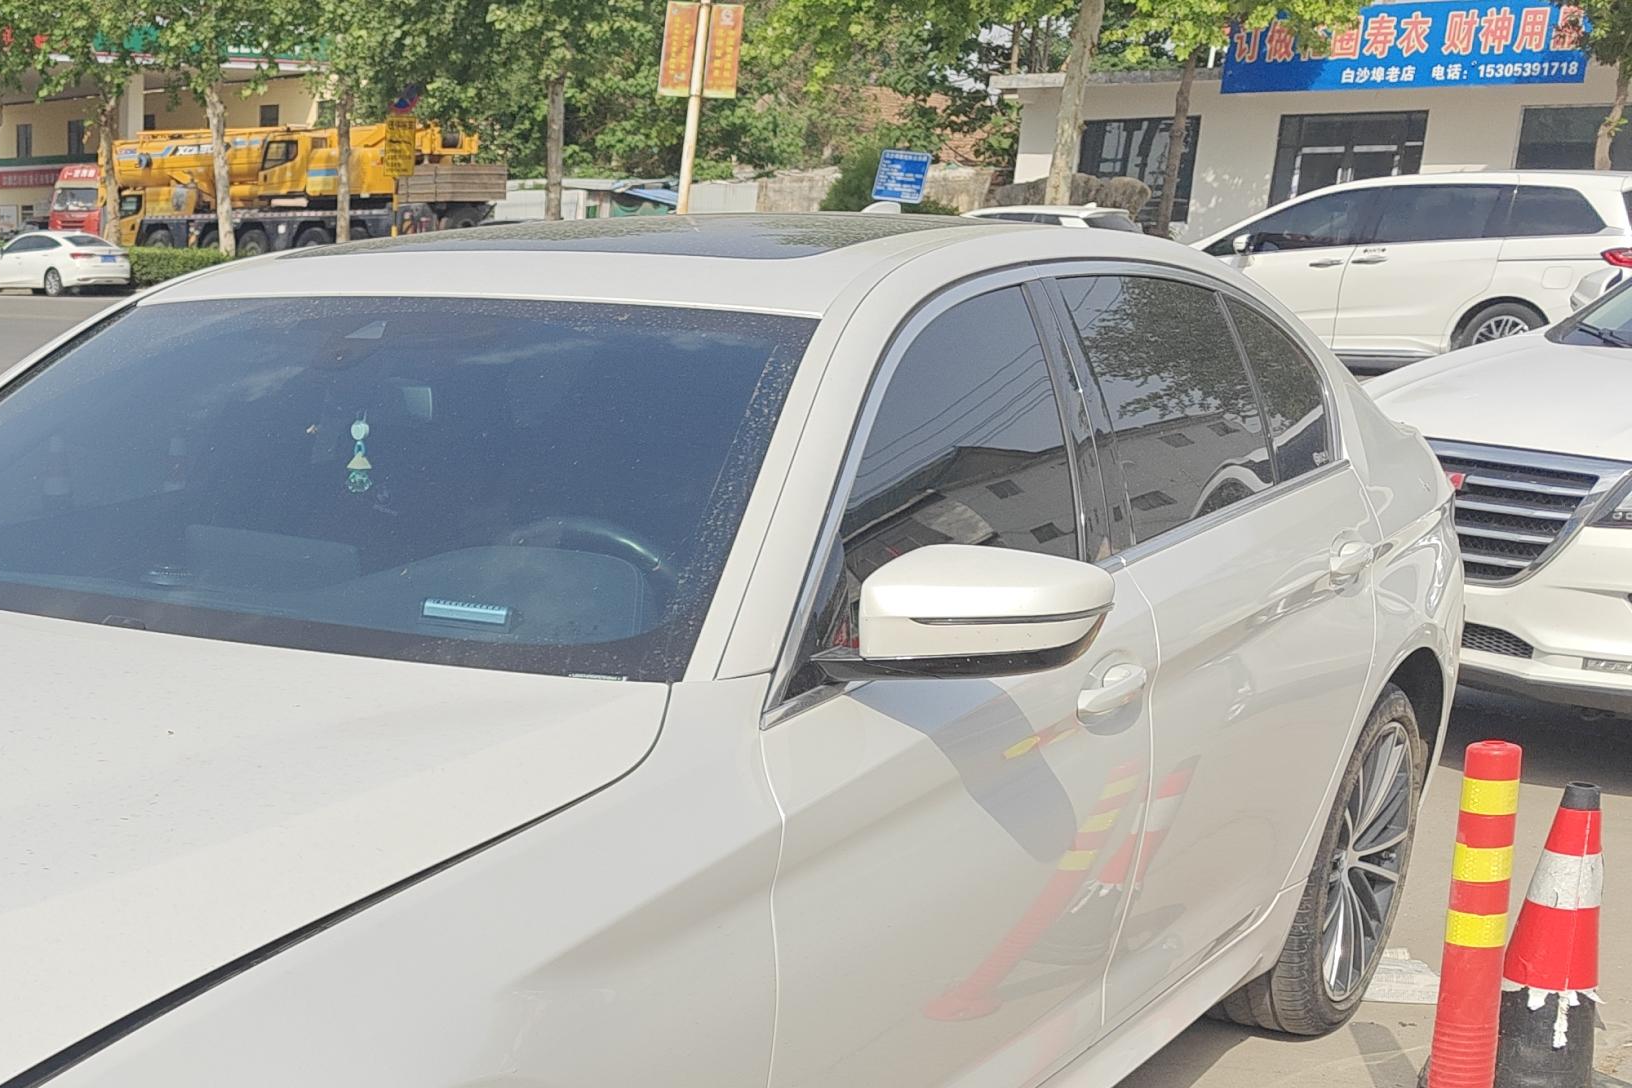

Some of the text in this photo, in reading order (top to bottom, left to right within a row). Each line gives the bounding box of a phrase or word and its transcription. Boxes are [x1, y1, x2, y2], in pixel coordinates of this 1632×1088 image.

[1340, 64, 1416, 84] 白沙埠老店
[1477, 60, 1580, 79] 15305391718
